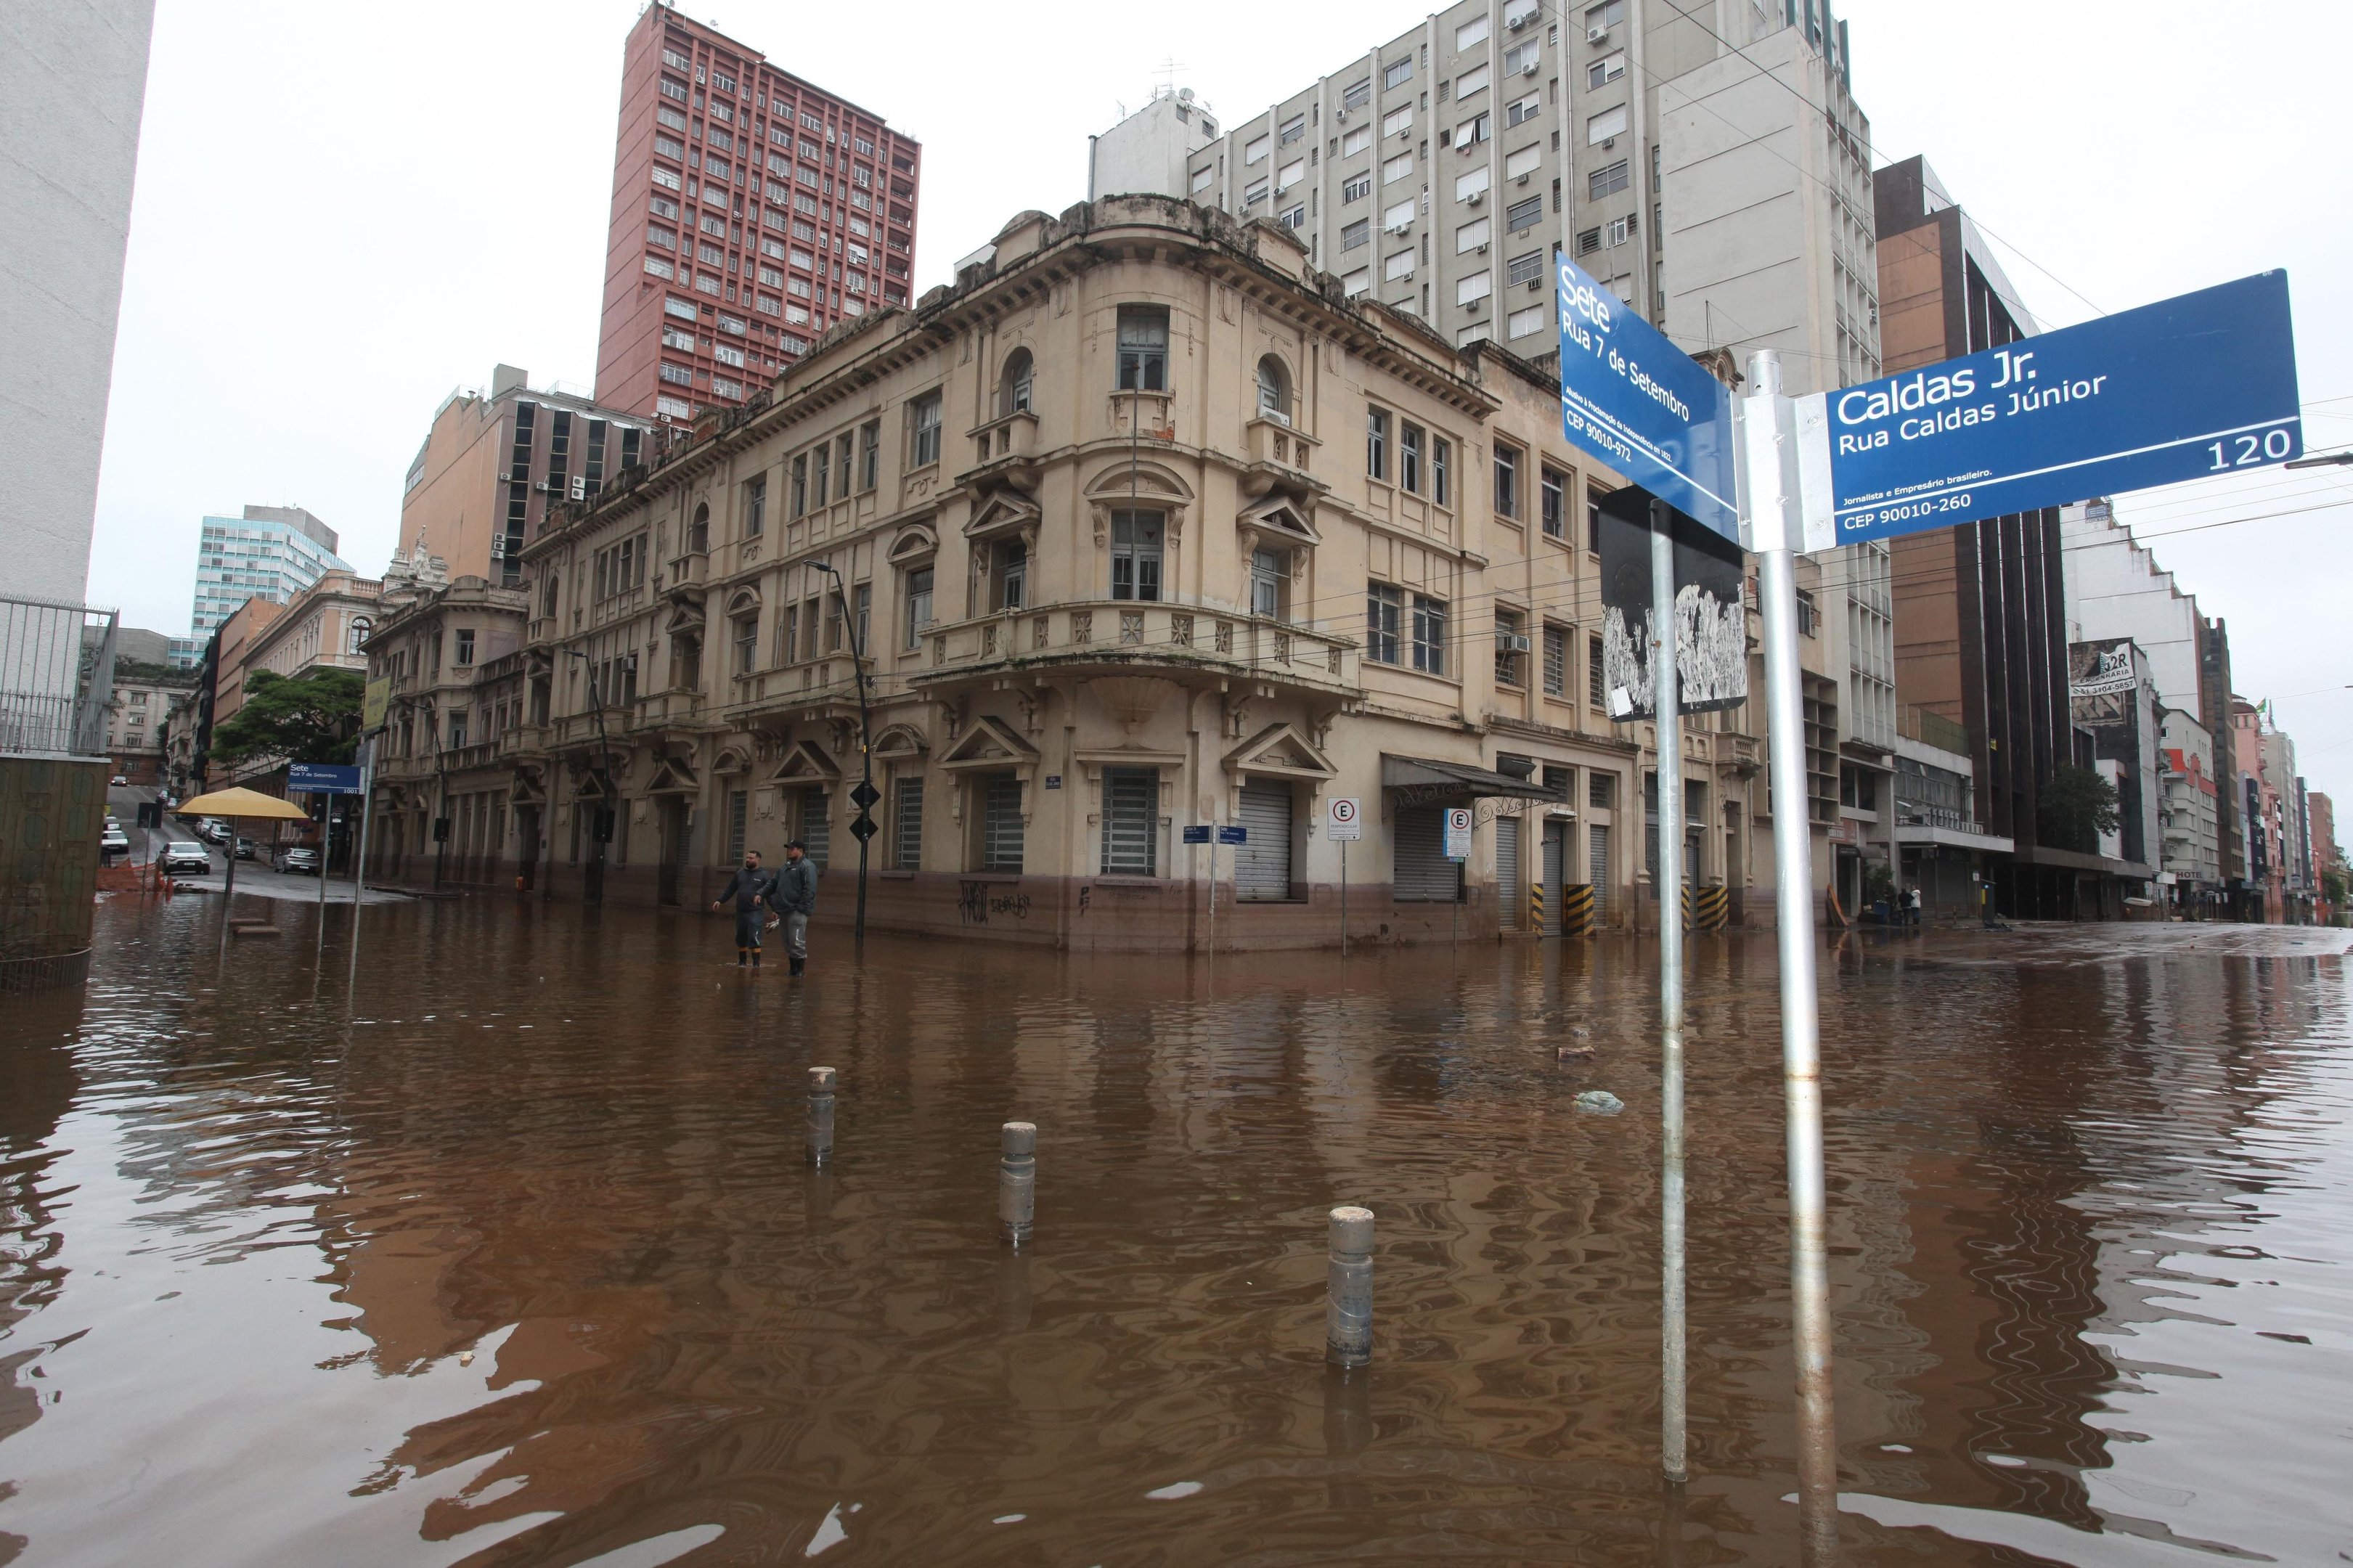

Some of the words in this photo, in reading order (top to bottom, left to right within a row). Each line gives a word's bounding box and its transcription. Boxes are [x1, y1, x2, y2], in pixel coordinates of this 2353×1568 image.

[1561, 265, 1610, 333] Sete
[1562, 310, 1591, 351] Rua
[1595, 335, 1604, 358] 7
[1609, 348, 1626, 376] de
[1629, 362, 1689, 422] Setembro
[1838, 369, 1975, 425] Caldas
[1991, 351, 2036, 389] Jr.
[1565, 385, 1583, 404] Alusivo
[1583, 397, 1588, 407] à
[1588, 400, 1616, 425] Proclamação
[1616, 420, 1623, 430] da
[1623, 424, 1653, 450] Independência
[1653, 446, 1660, 454] em
[1661, 449, 1673, 462] 1822.
[1567, 410, 1584, 431] CEP
[1586, 422, 1631, 462] 90010-972
[1839, 430, 1889, 456] Rua
[1900, 404, 1996, 441] Caldas
[2007, 375, 2107, 416] Júnior
[2208, 429, 2291, 470] 120
[1843, 489, 1884, 506] Jornalista
[1894, 479, 1944, 496] Empresário
[1946, 469, 1993, 484] brasileiro.
[1844, 513, 1875, 530] CEP
[1880, 494, 1971, 523] 90010-260
[2092, 680, 2133, 693] 3104-5857
[1340, 806, 1347, 817] E
[1456, 814, 1464, 825] E
